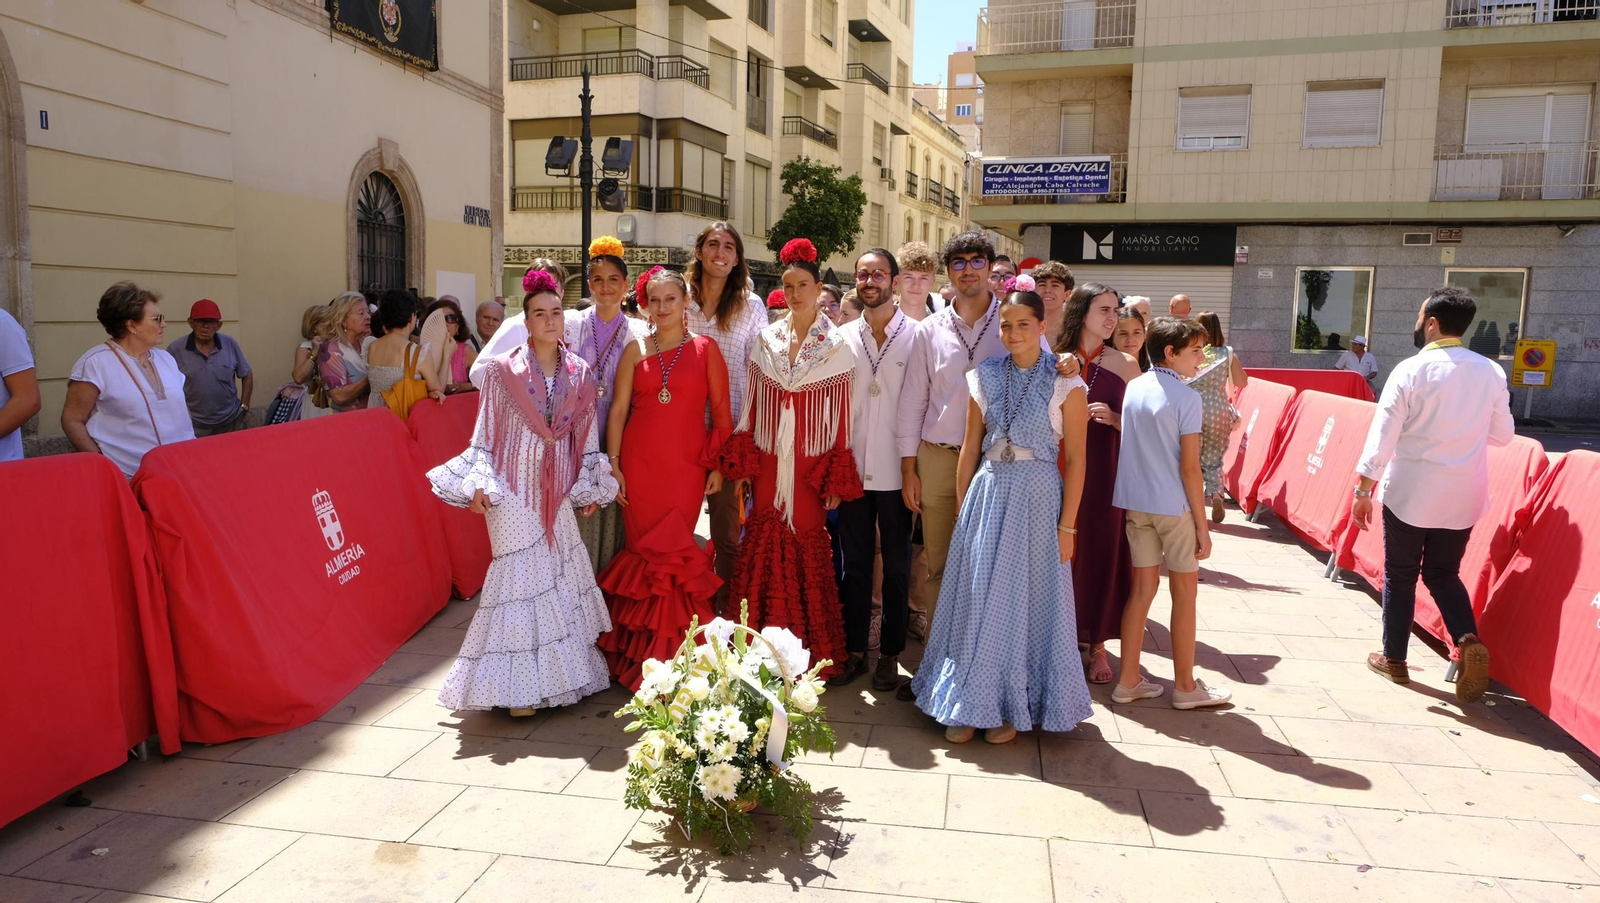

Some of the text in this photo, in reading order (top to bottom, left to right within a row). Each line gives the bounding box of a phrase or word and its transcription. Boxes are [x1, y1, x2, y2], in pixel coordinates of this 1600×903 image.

[987, 163, 1106, 174] CLINICA DENTAL
[1122, 234, 1200, 245] MAÑAS CANO
[325, 543, 365, 577] ALMERÍA
[338, 565, 360, 585] CIUDAD
